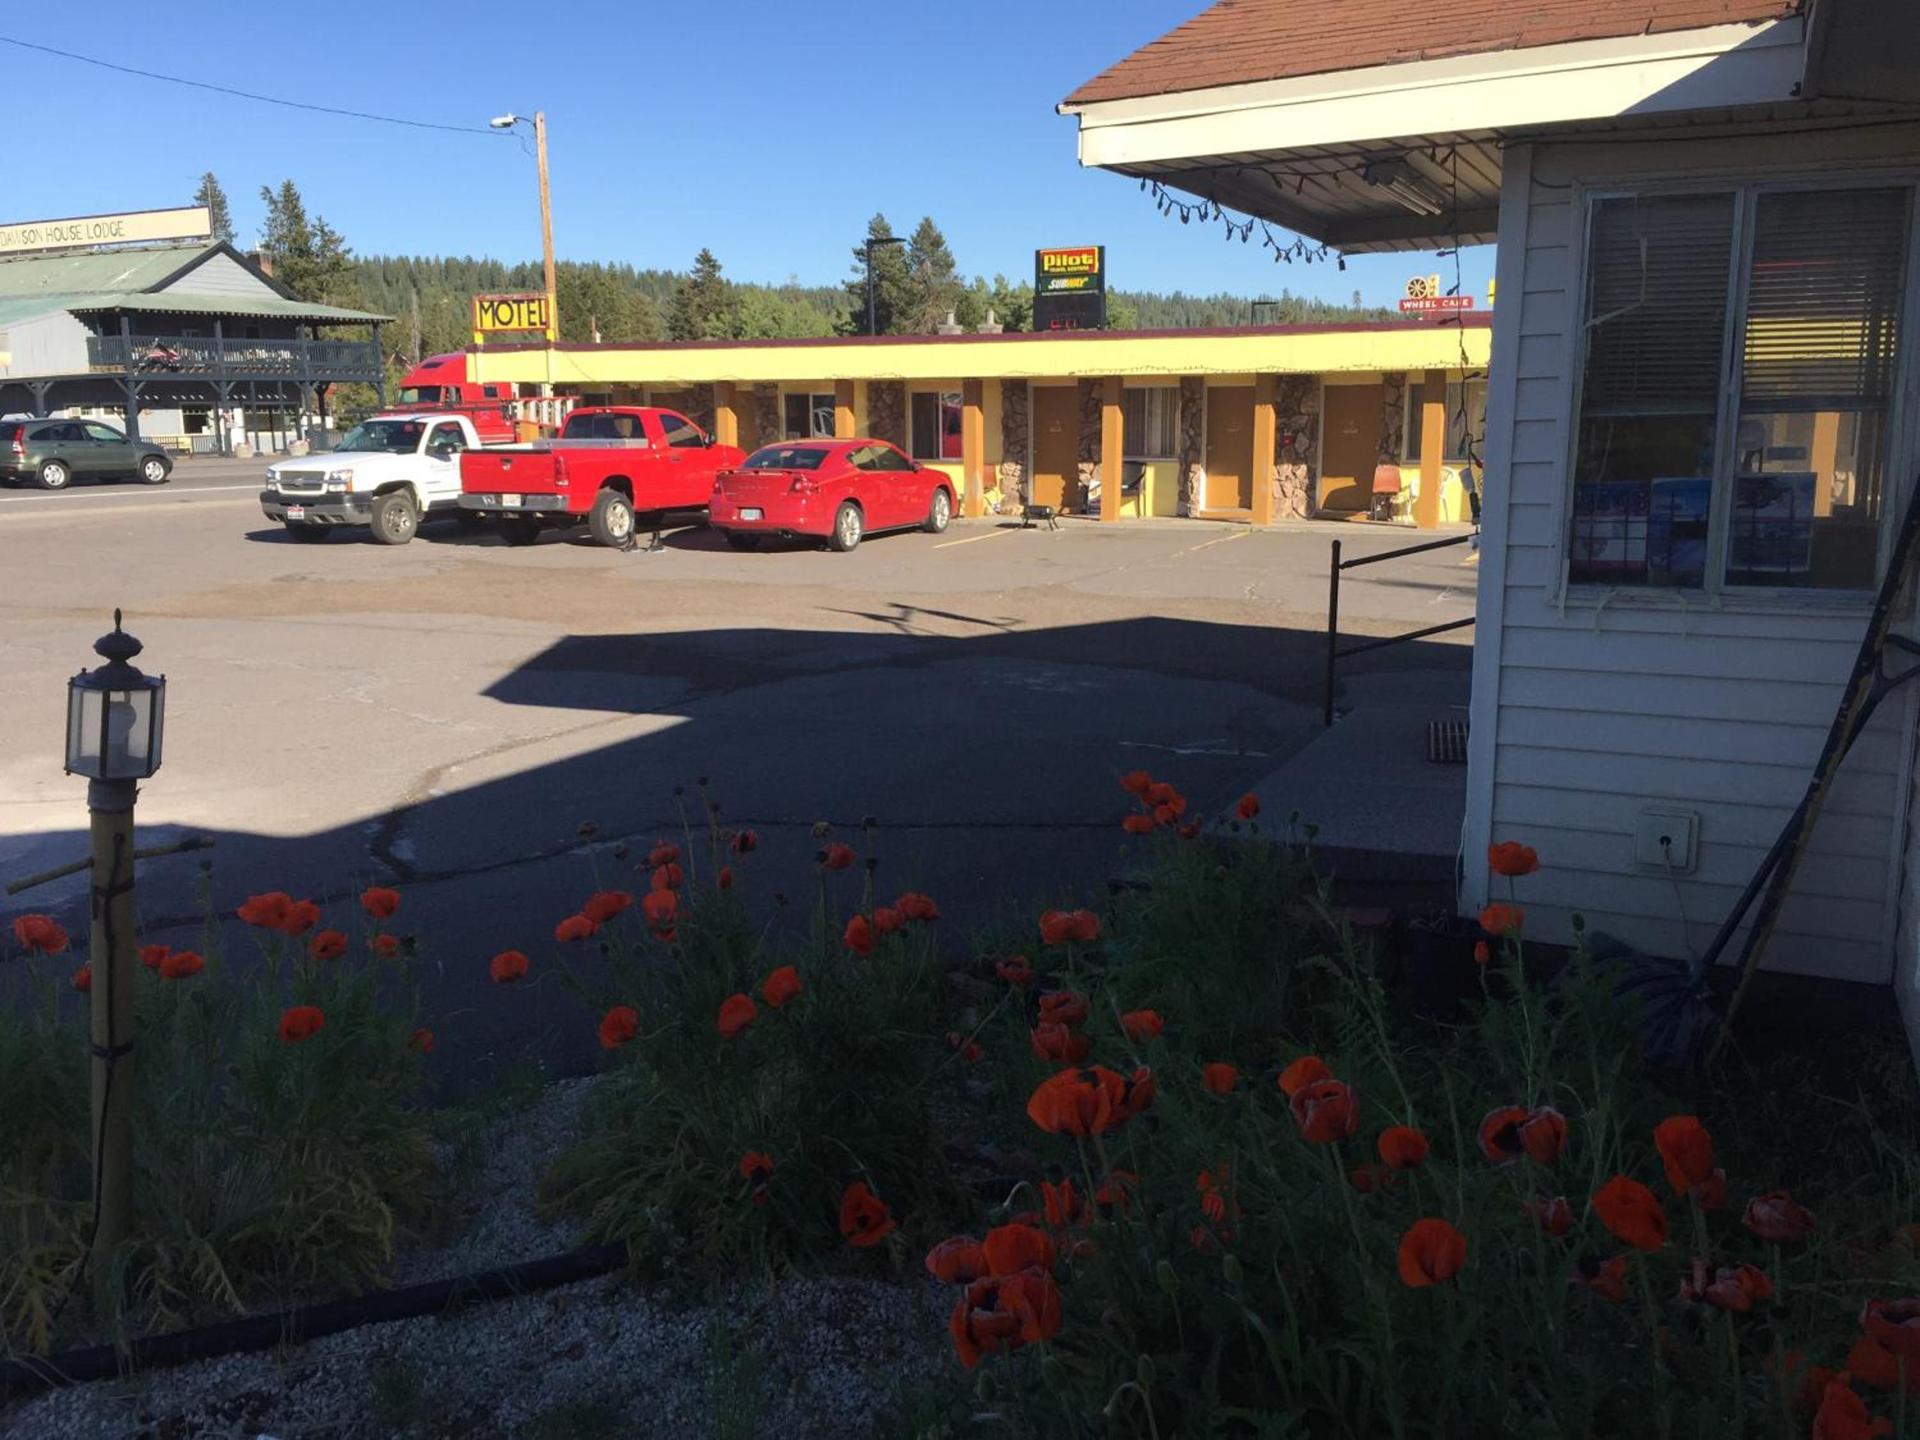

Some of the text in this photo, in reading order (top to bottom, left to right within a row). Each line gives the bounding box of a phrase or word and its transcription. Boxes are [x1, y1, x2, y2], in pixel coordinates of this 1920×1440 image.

[46, 224, 83, 243] HOUSE
[86, 220, 125, 240] LODGE
[479, 298, 547, 328] MOTEL
[1402, 300, 1437, 309] WHEEL
